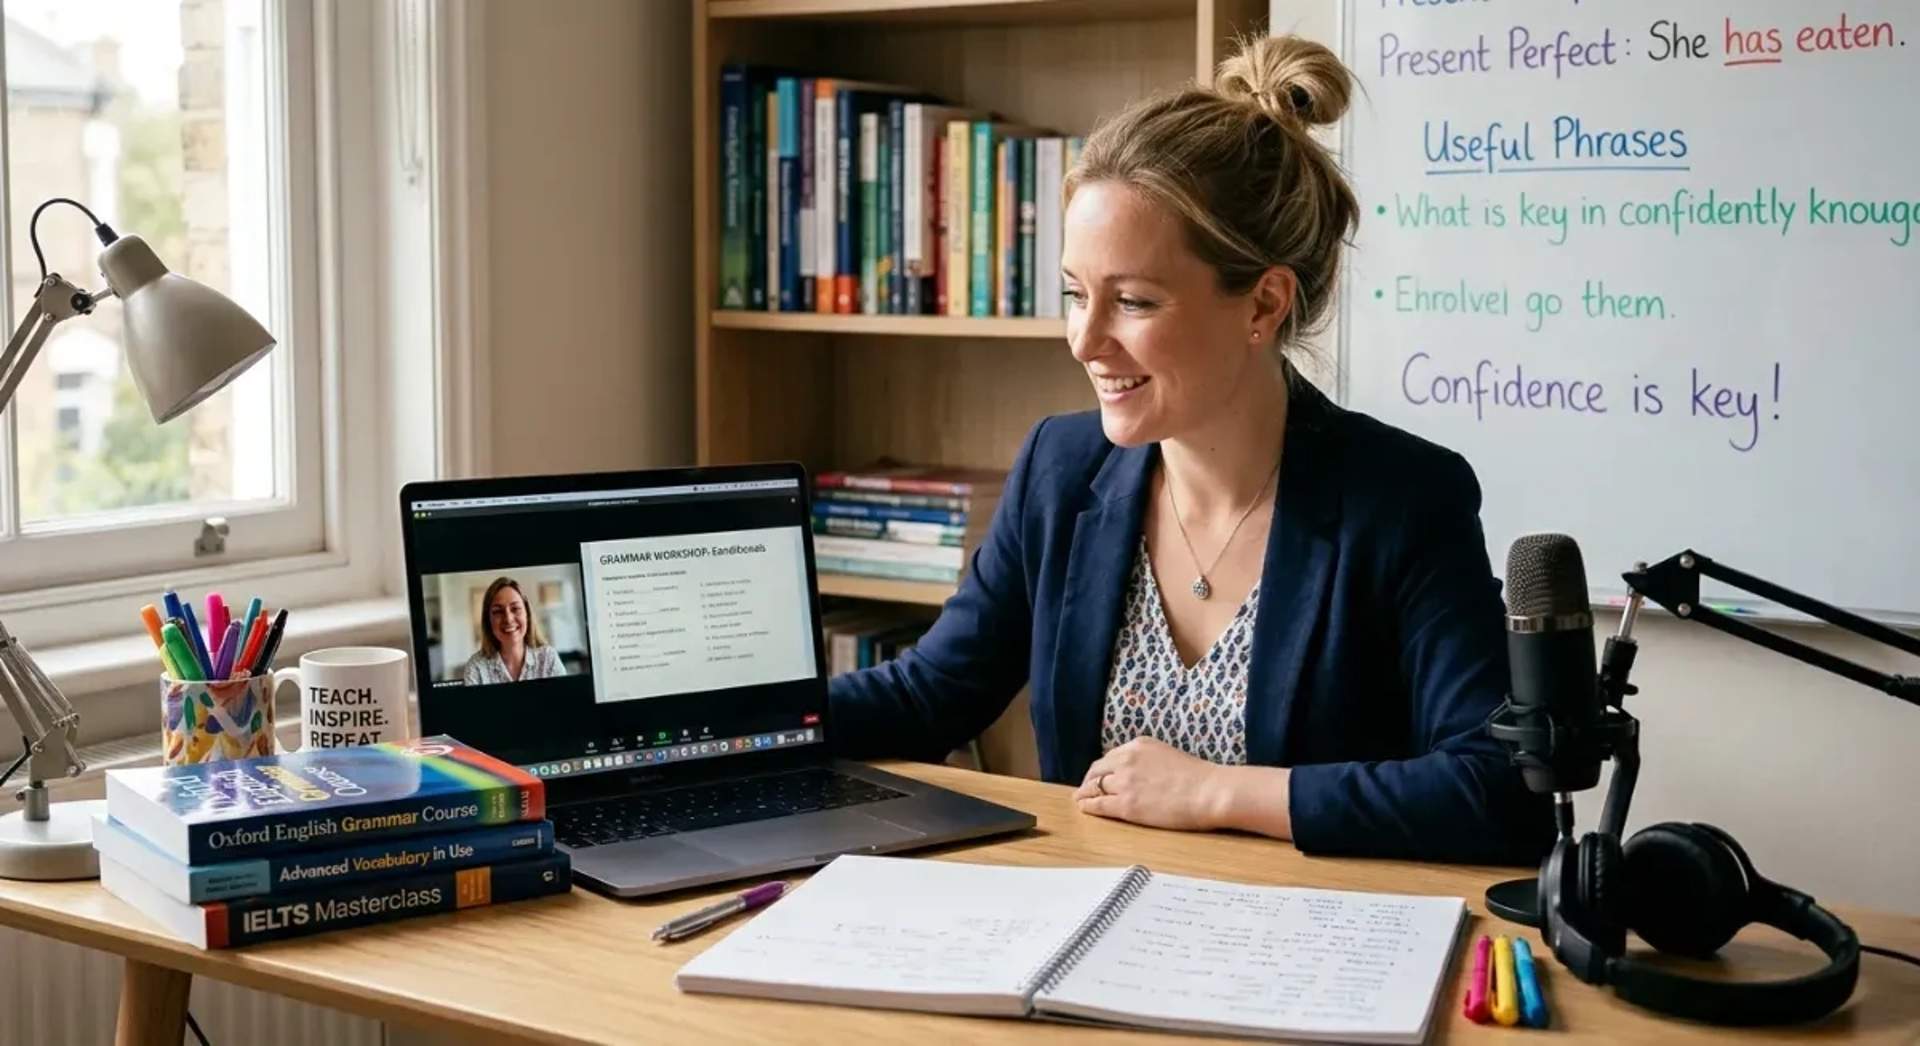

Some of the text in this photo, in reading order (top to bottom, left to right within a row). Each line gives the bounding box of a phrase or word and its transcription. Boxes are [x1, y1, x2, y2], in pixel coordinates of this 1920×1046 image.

[1379, 32, 1491, 77] Present
[1648, 19, 1709, 61] She
[1724, 17, 1783, 54] has
[1796, 12, 1906, 52] eaten.
[1424, 115, 1688, 173] Useful Phrases
[1394, 191, 1470, 227] What
[1484, 198, 1507, 227] is
[1520, 191, 1568, 246] key
[1581, 196, 1606, 225] in
[1619, 187, 1796, 236] confidently
[1526, 292, 1563, 332] go
[1402, 352, 1781, 452] Confidence is key!
[599, 552, 652, 566] GRAMMAR
[309, 686, 378, 706] TEACH.
[309, 708, 389, 728] INSPIRE.
[208, 831, 270, 850] Oxford
[274, 818, 337, 841] English
[341, 811, 418, 833] Grammar
[422, 802, 479, 823] Course
[280, 857, 349, 883] Advanced
[433, 846, 446, 861] in
[449, 844, 475, 859] Use
[243, 903, 310, 934] IELTS
[315, 887, 442, 922] Masterclass
